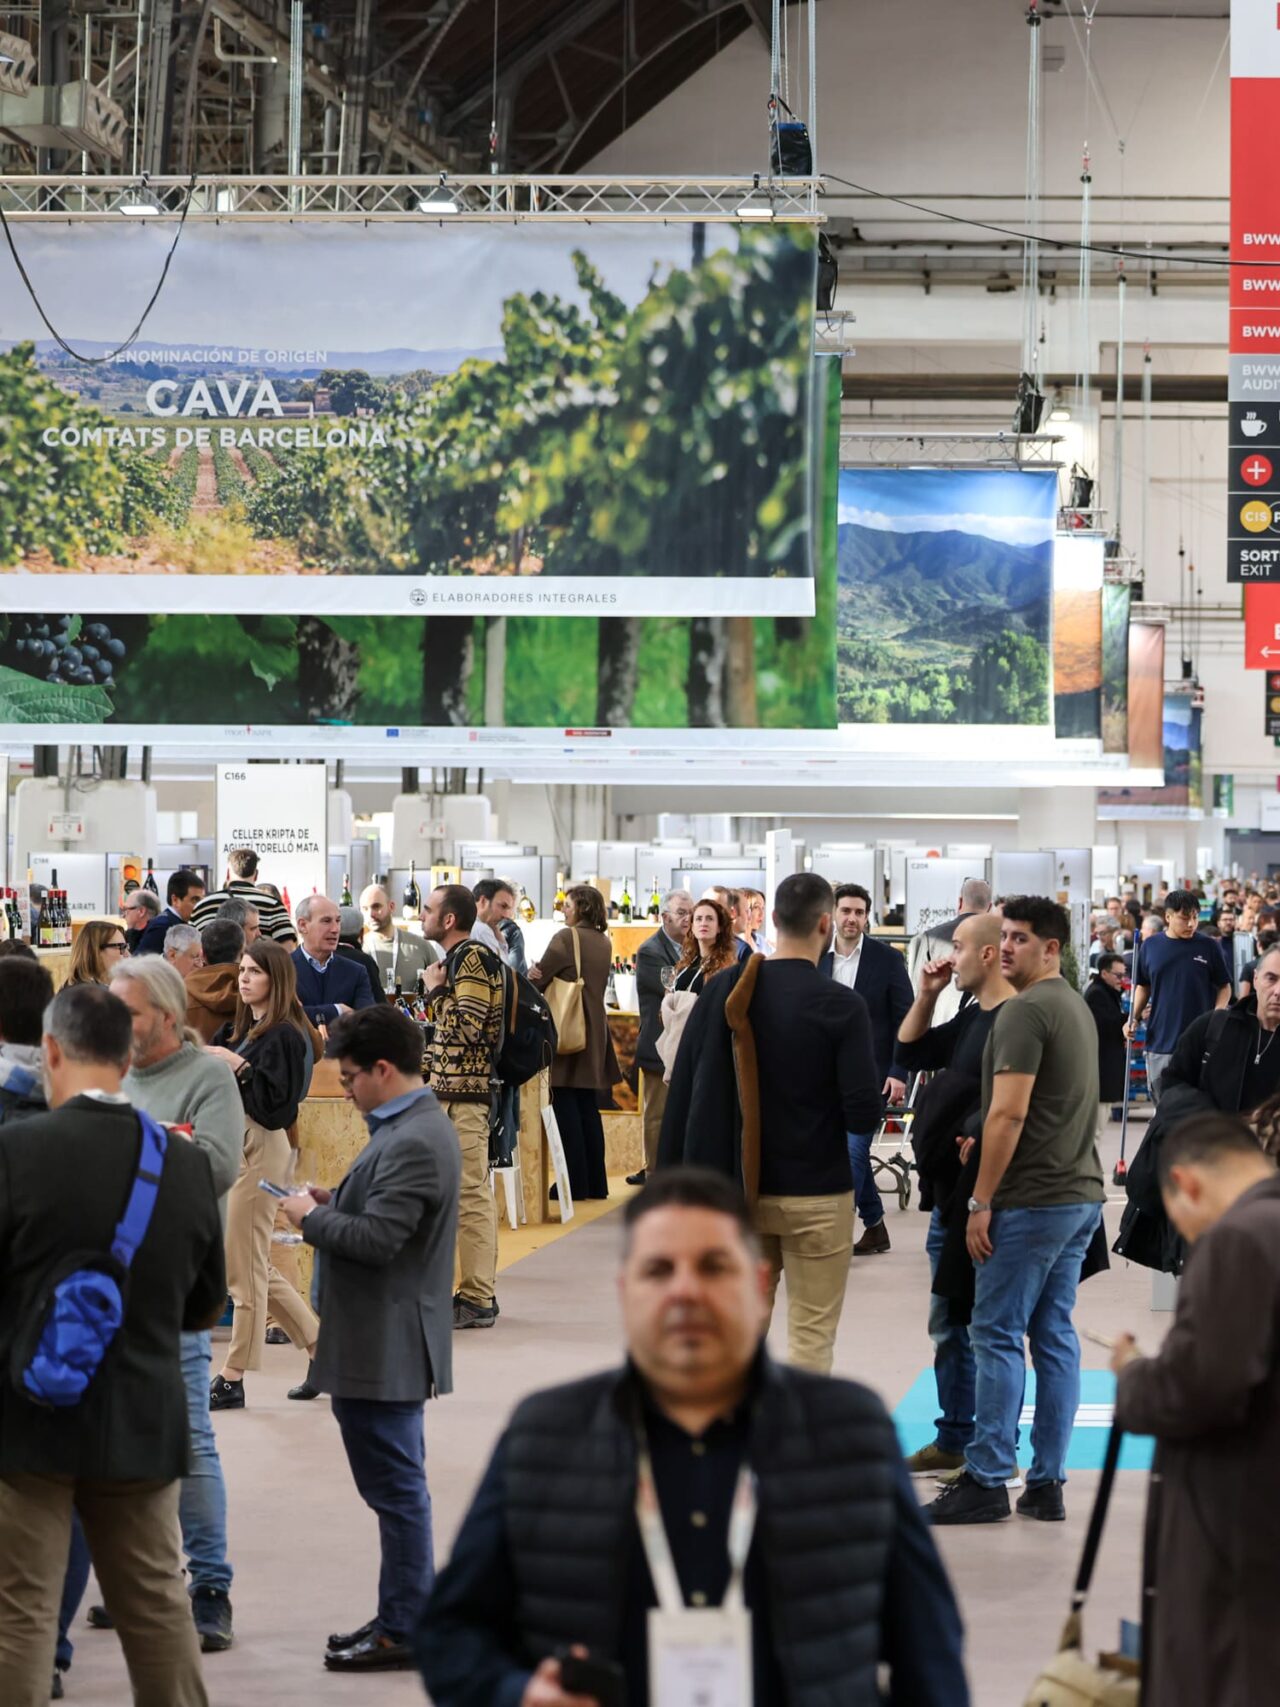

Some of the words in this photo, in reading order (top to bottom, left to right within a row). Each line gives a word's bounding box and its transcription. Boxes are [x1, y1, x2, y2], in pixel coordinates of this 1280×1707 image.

[104, 348, 231, 363] DENOMINACIÓN
[238, 351, 259, 363] DE
[268, 351, 328, 363] ORIGEN
[1242, 365, 1280, 376] BWW
[146, 379, 284, 417] CAVA
[42, 427, 166, 448] COMTATS
[176, 427, 210, 448] DE
[219, 427, 387, 448] BARCELONA
[1245, 511, 1268, 522] CIS
[1240, 564, 1272, 576] EXIT
[432, 592, 534, 603] ELABORADORES
[538, 593, 617, 603] INTEGRALES
[224, 772, 246, 780] C166
[232, 829, 264, 839] CELLER
[266, 829, 295, 839] KRIPTA
[298, 829, 309, 839] DE
[256, 841, 294, 853] TORELLÓ
[296, 843, 319, 853] MATA
